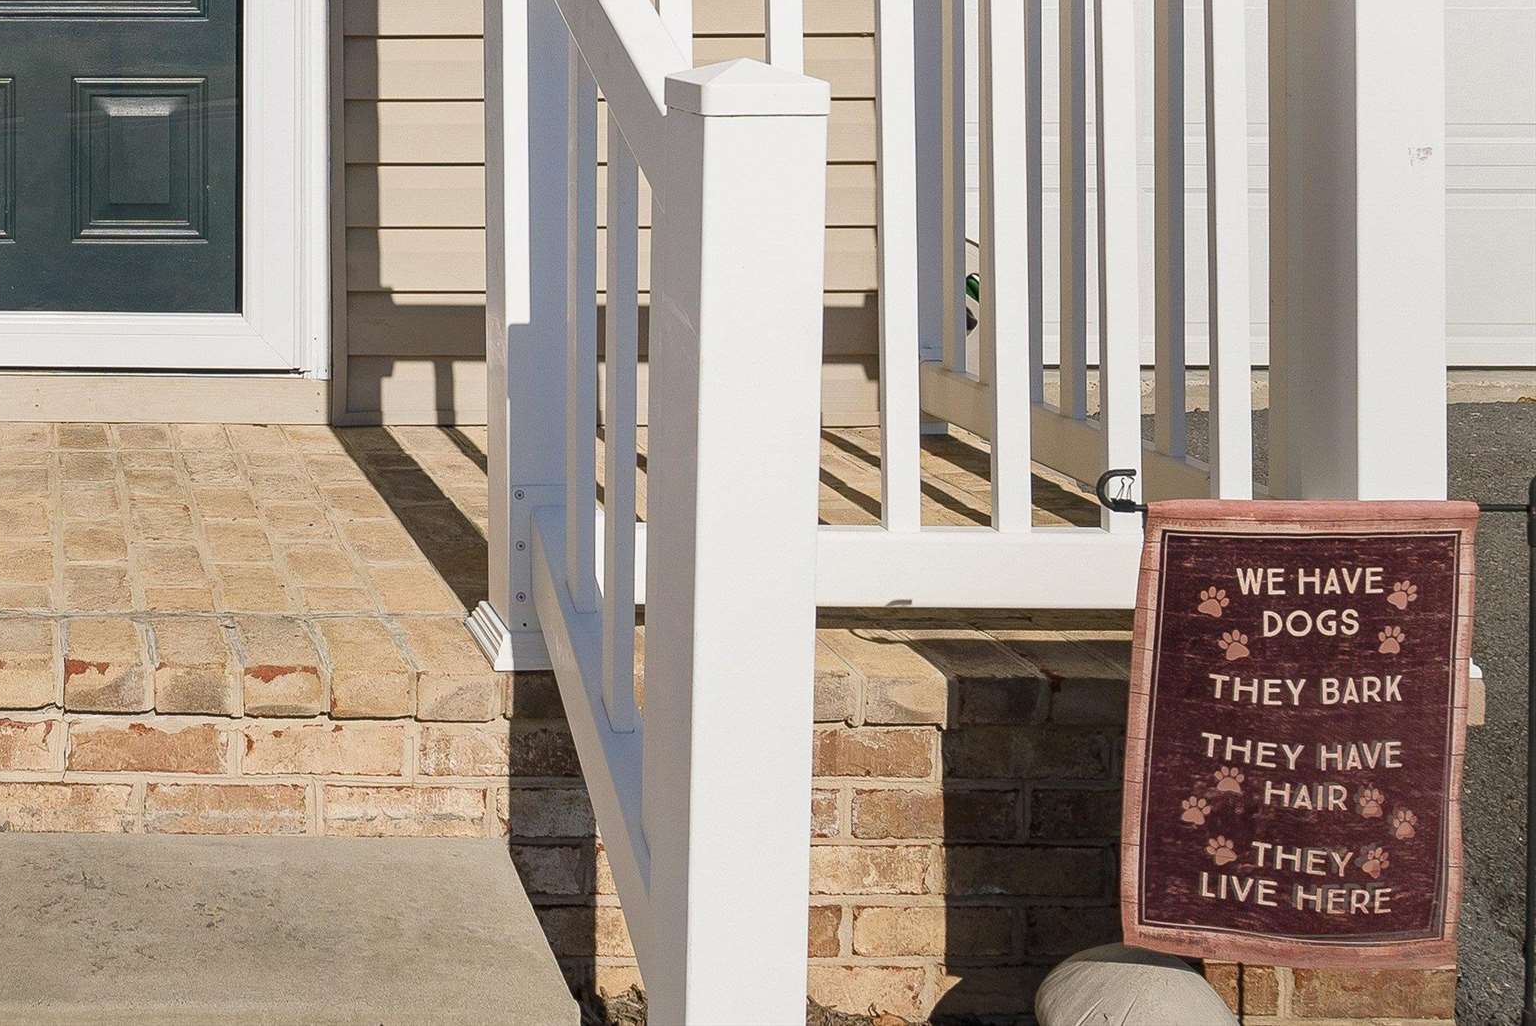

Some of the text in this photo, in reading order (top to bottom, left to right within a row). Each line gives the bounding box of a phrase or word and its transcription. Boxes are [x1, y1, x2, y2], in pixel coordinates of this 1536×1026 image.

[1236, 566, 1384, 595] WE HAVE
[1263, 608, 1360, 637] DOGS
[1209, 673, 1403, 706] THEY BARK
[1201, 732, 1403, 771] THEY HAVE
[1263, 780, 1348, 811] HAIR
[1251, 840, 1354, 878] THEY
[1200, 871, 1393, 915] LIVE HERE
